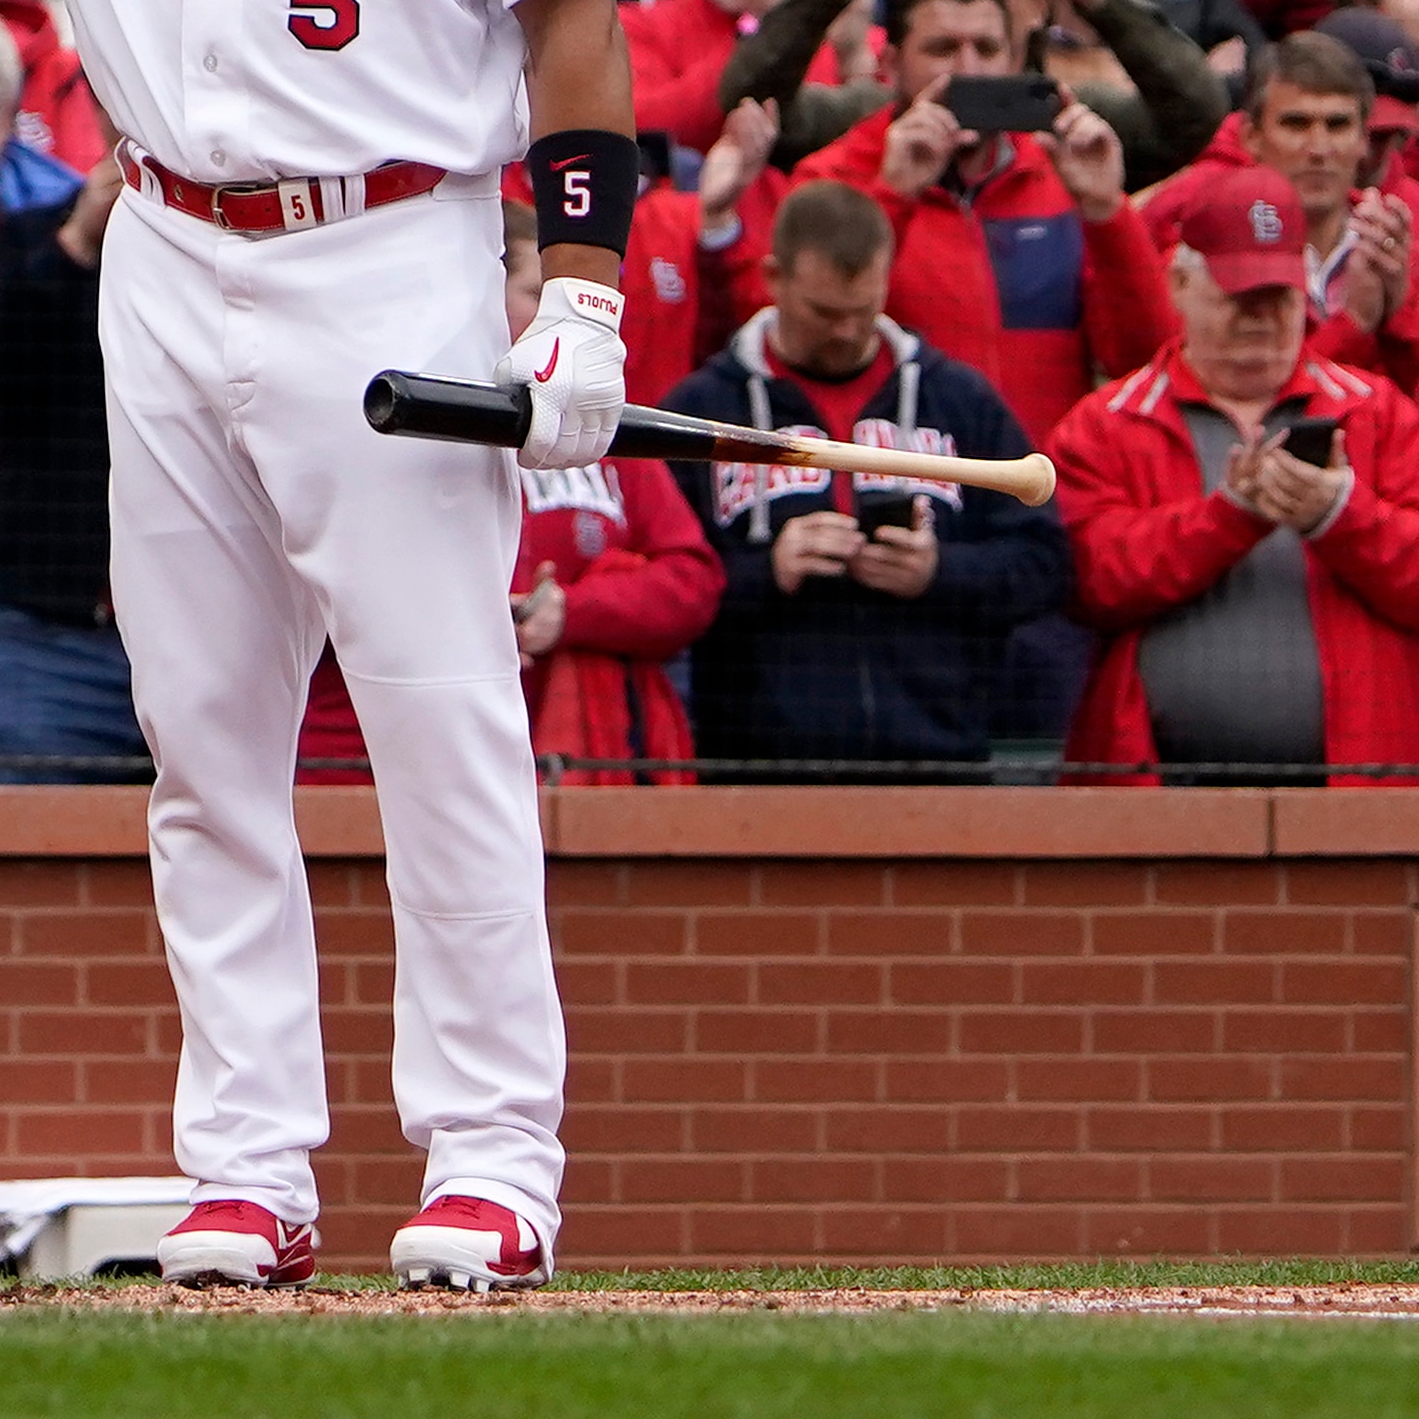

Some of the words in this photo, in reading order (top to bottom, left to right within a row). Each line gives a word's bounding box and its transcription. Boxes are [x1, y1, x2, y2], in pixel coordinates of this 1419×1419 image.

[564, 171, 591, 216] 5
[292, 195, 305, 220] 5
[577, 293, 619, 316] PUJOLS
